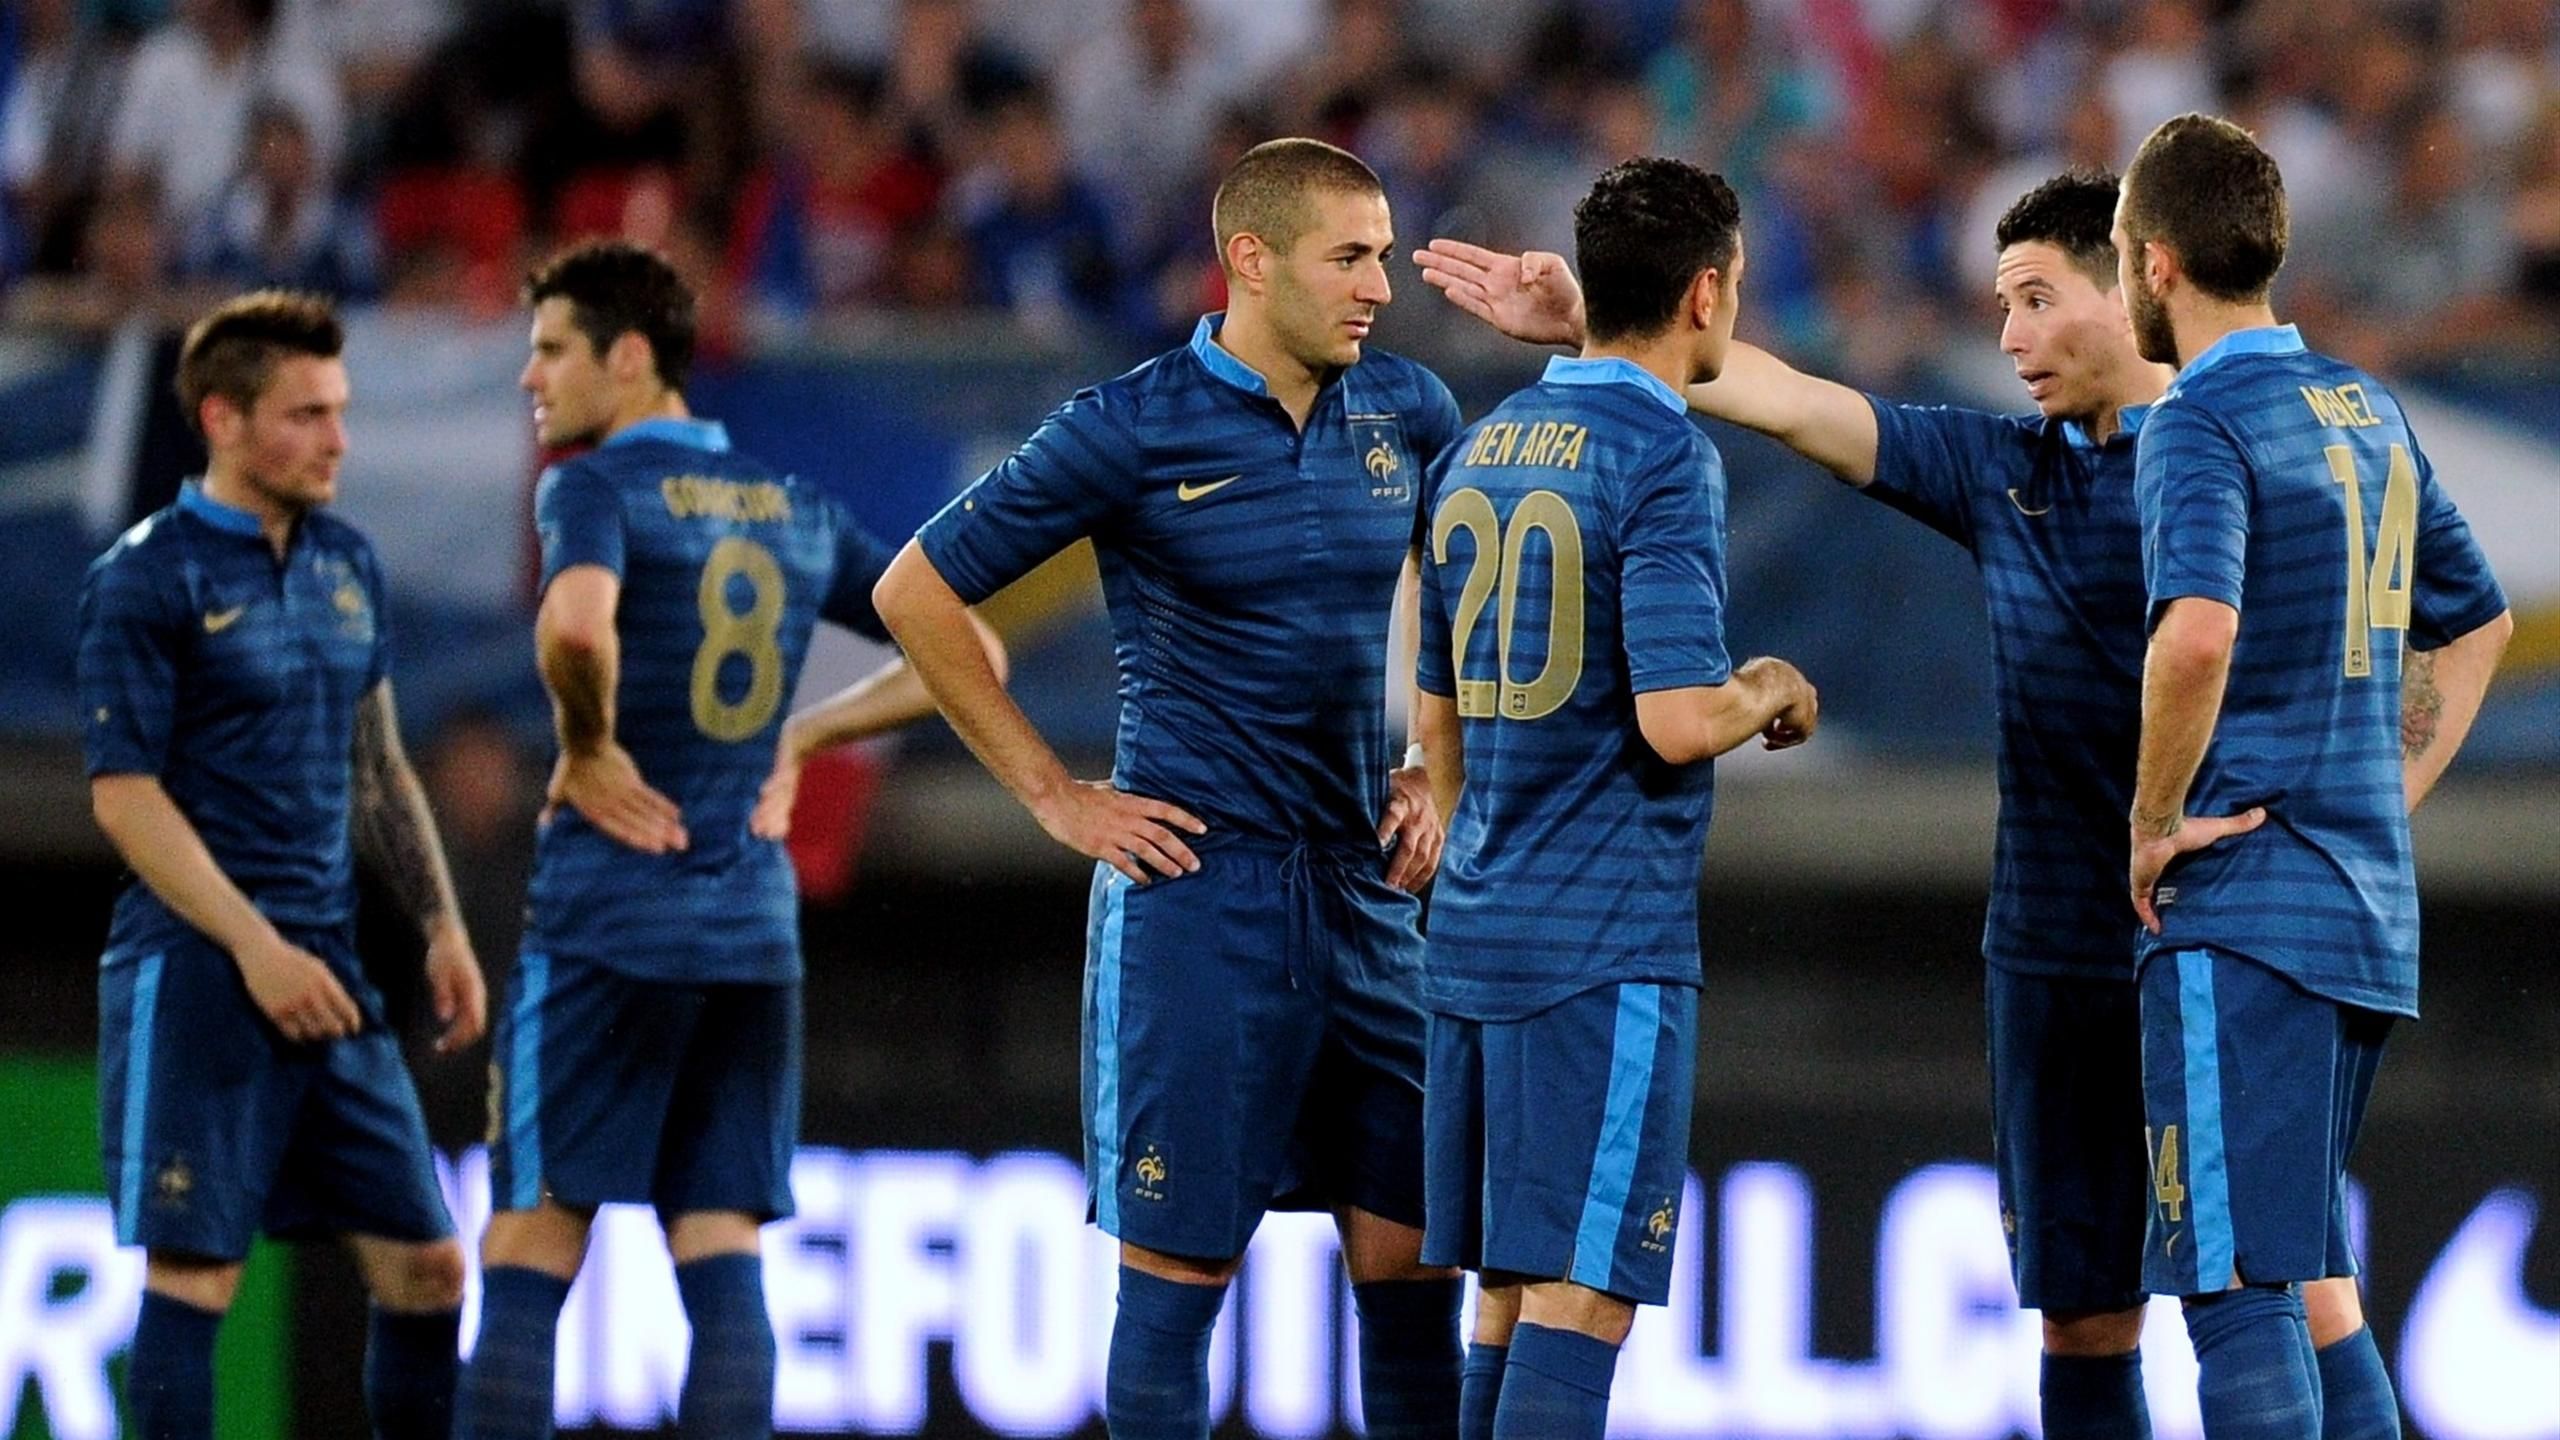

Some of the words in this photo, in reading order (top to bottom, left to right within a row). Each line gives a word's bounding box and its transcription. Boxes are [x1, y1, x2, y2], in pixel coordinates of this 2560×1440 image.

[1464, 421, 1523, 467] BEN
[1514, 420, 1588, 471] ARFA
[690, 537, 786, 742] 8
[1432, 487, 1585, 720] 20
[2323, 443, 2417, 678] 14
[2145, 1124, 2185, 1222] 4
